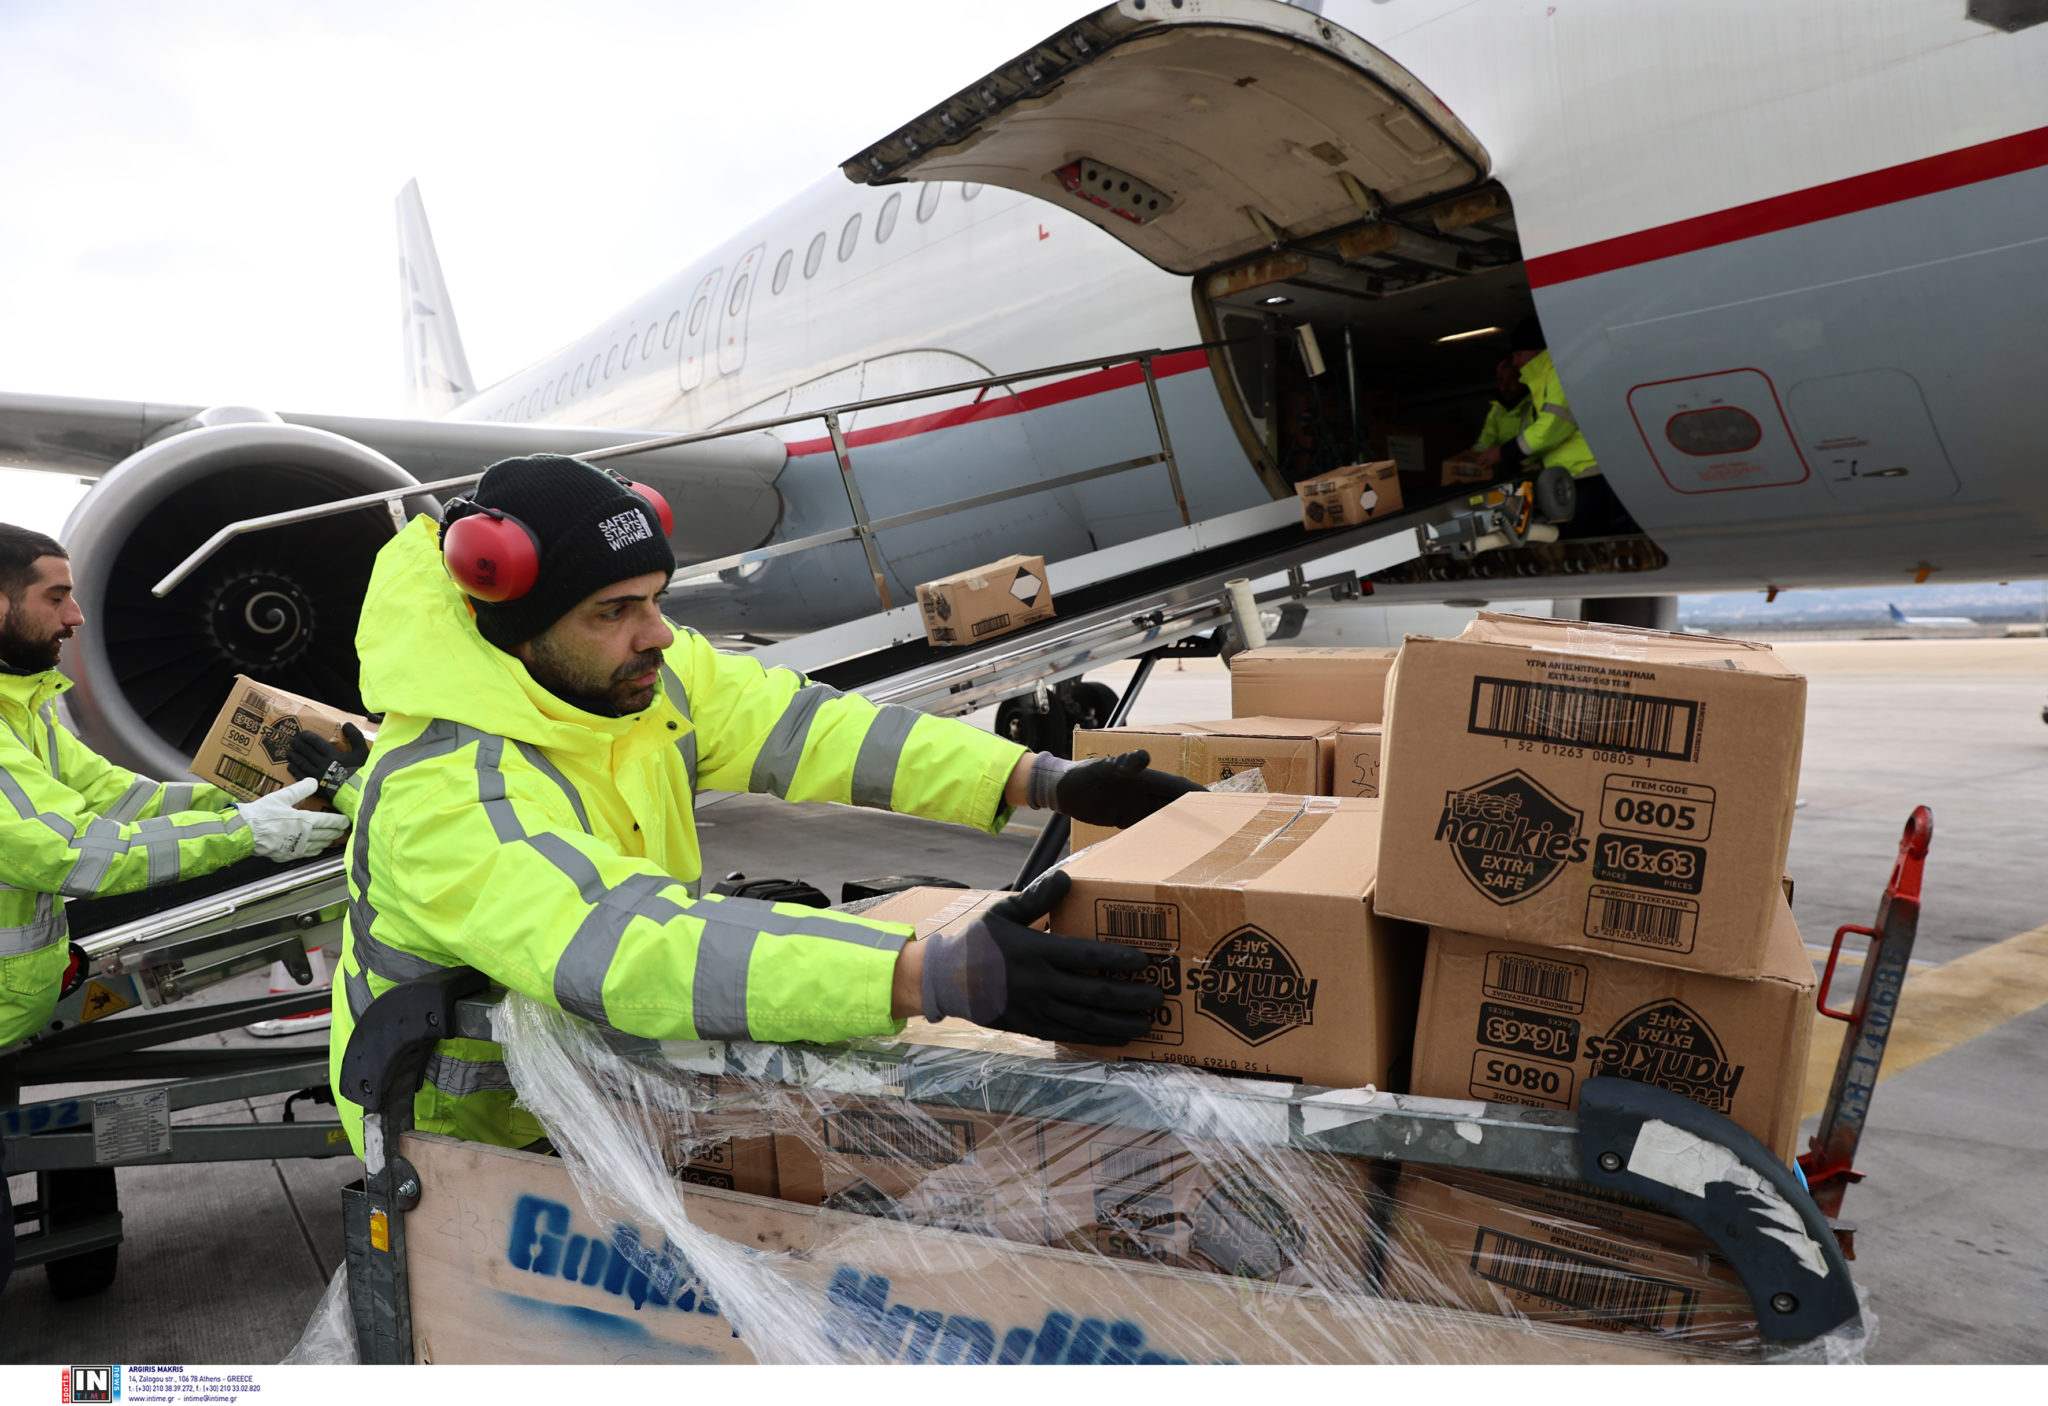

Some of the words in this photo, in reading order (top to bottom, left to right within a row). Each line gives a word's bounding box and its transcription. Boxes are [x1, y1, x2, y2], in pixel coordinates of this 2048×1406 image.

[598, 510, 636, 531] SAFETY
[604, 519, 643, 541] STARTS
[1548, 671, 1575, 682] EXTRA
[228, 729, 250, 746] 0805
[1518, 740, 1534, 751] 52
[1542, 743, 1584, 759] 01263
[1592, 751, 1635, 766] 00805
[1631, 780, 1657, 791] ITEM
[1659, 784, 1688, 795] CODE
[1615, 797, 1696, 831] 0805
[1434, 807, 1591, 863] hankies
[1480, 855, 1534, 875] EXTRA
[1604, 841, 1695, 879] 16x63
[1482, 872, 1526, 891] SAFE
[1601, 869, 1628, 881] PACKS
[1664, 879, 1694, 890] PIECES
[1233, 939, 1270, 953] SAFE
[1227, 954, 1274, 969] EXTRA
[1648, 1012, 1693, 1031] SAFE
[1486, 1016, 1569, 1055] 16x63
[1638, 1026, 1695, 1049] EXTRA
[1164, 1052, 1196, 1064] 00805
[1203, 1057, 1237, 1069] 01263
[1244, 1061, 1257, 1072] 52
[1486, 1060, 1560, 1094] 0805
[1493, 1092, 1519, 1104] CODE
[1521, 1099, 1544, 1109] ITEM
[5, 1101, 80, 1133] 192
[1516, 1291, 1530, 1304] 52
